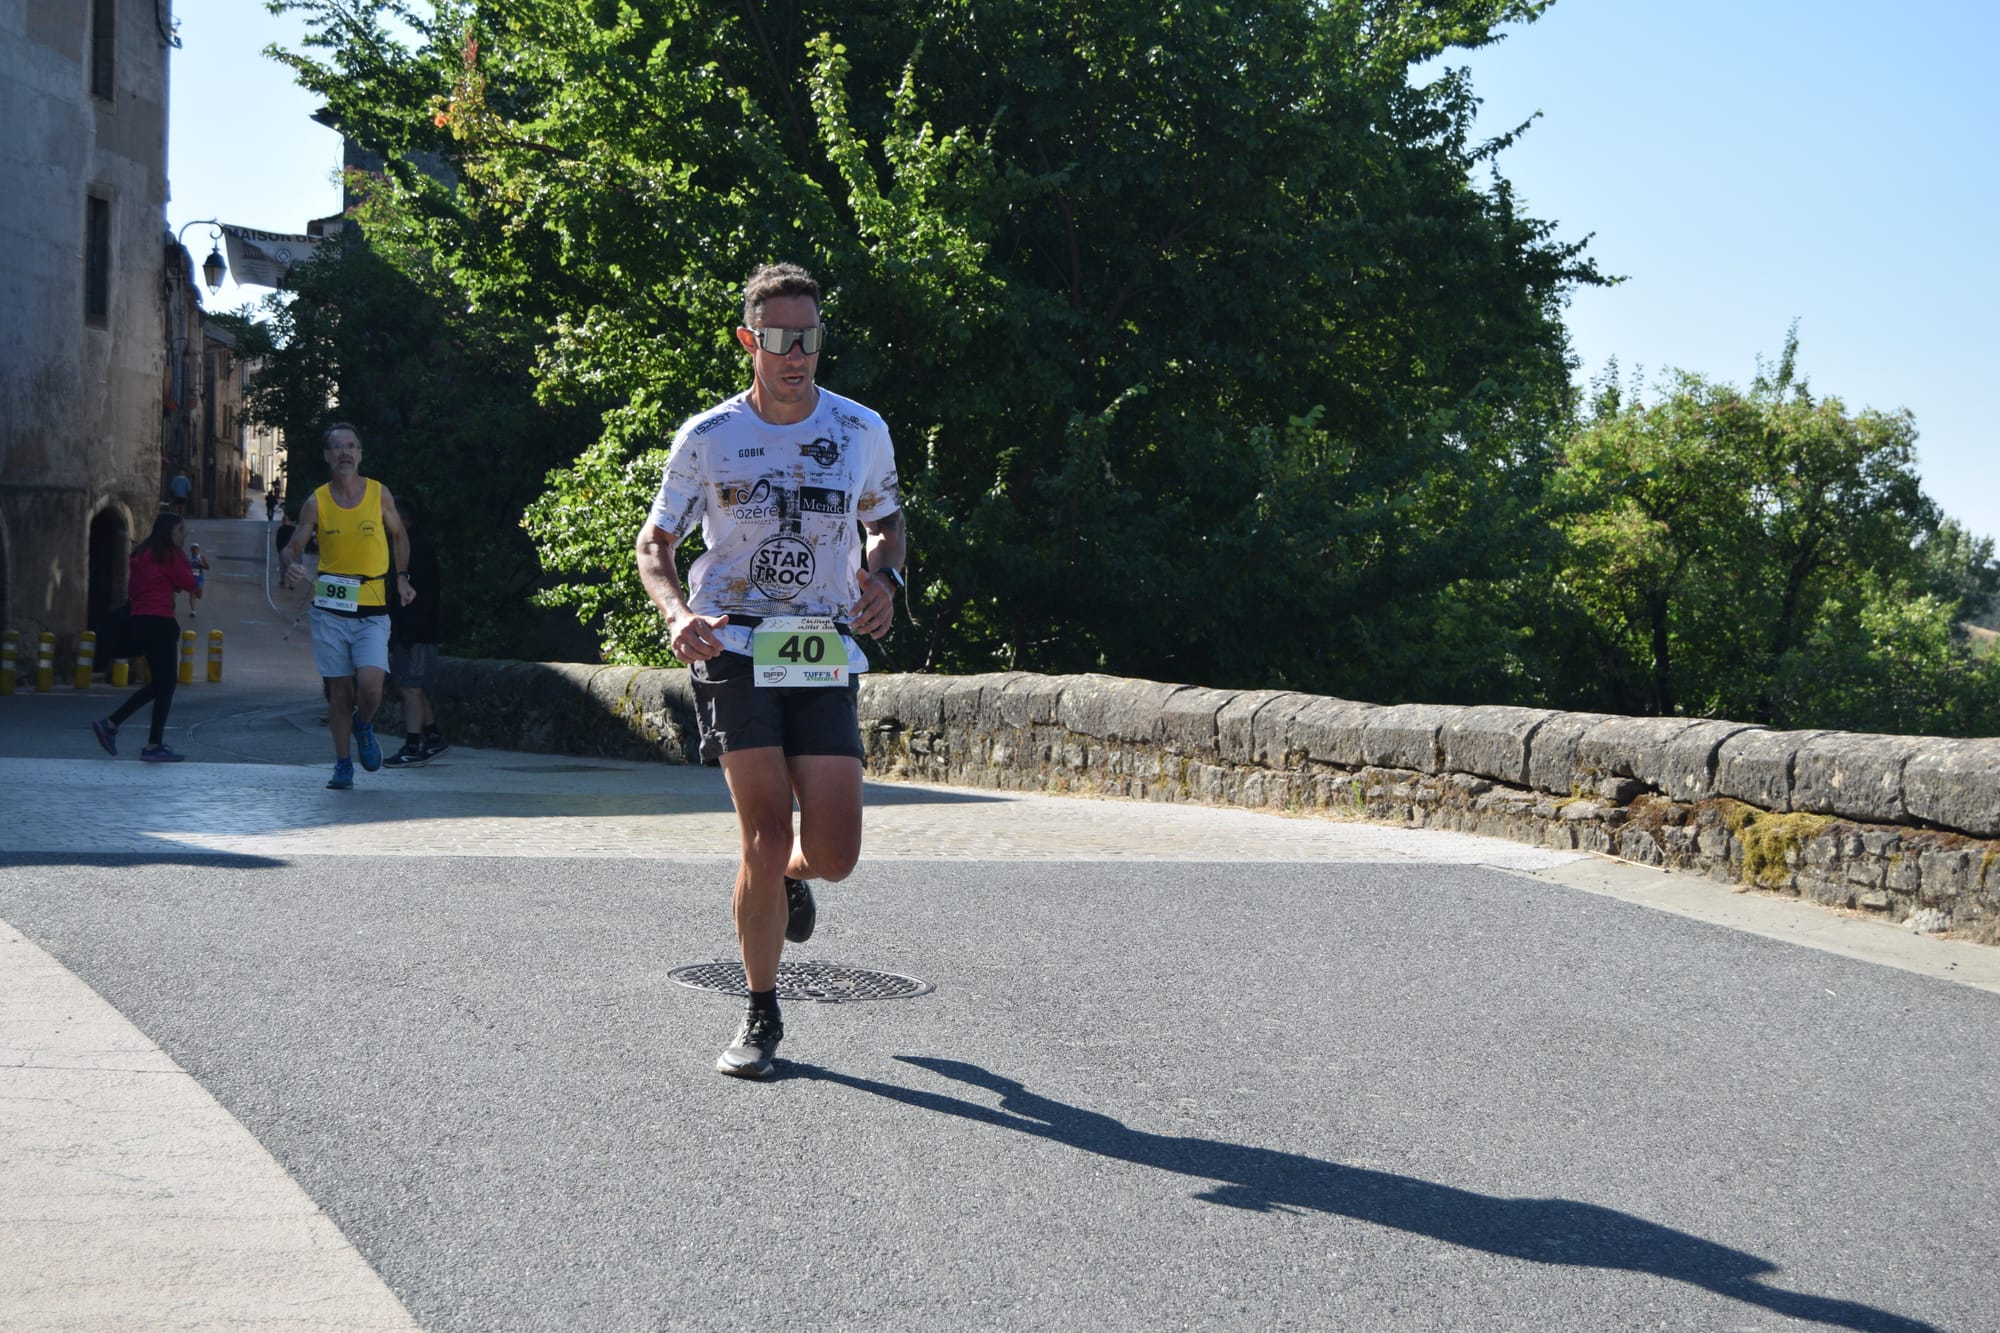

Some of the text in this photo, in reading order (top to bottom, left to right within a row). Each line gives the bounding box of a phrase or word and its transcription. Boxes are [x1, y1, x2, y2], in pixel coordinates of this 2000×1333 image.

[738, 447, 765, 458] GOBIK
[732, 505, 779, 520] lozère
[802, 497, 843, 514] Mende
[758, 549, 810, 568] STAR
[755, 564, 810, 586] TROC
[326, 584, 347, 599] 98
[778, 635, 825, 663] 40
